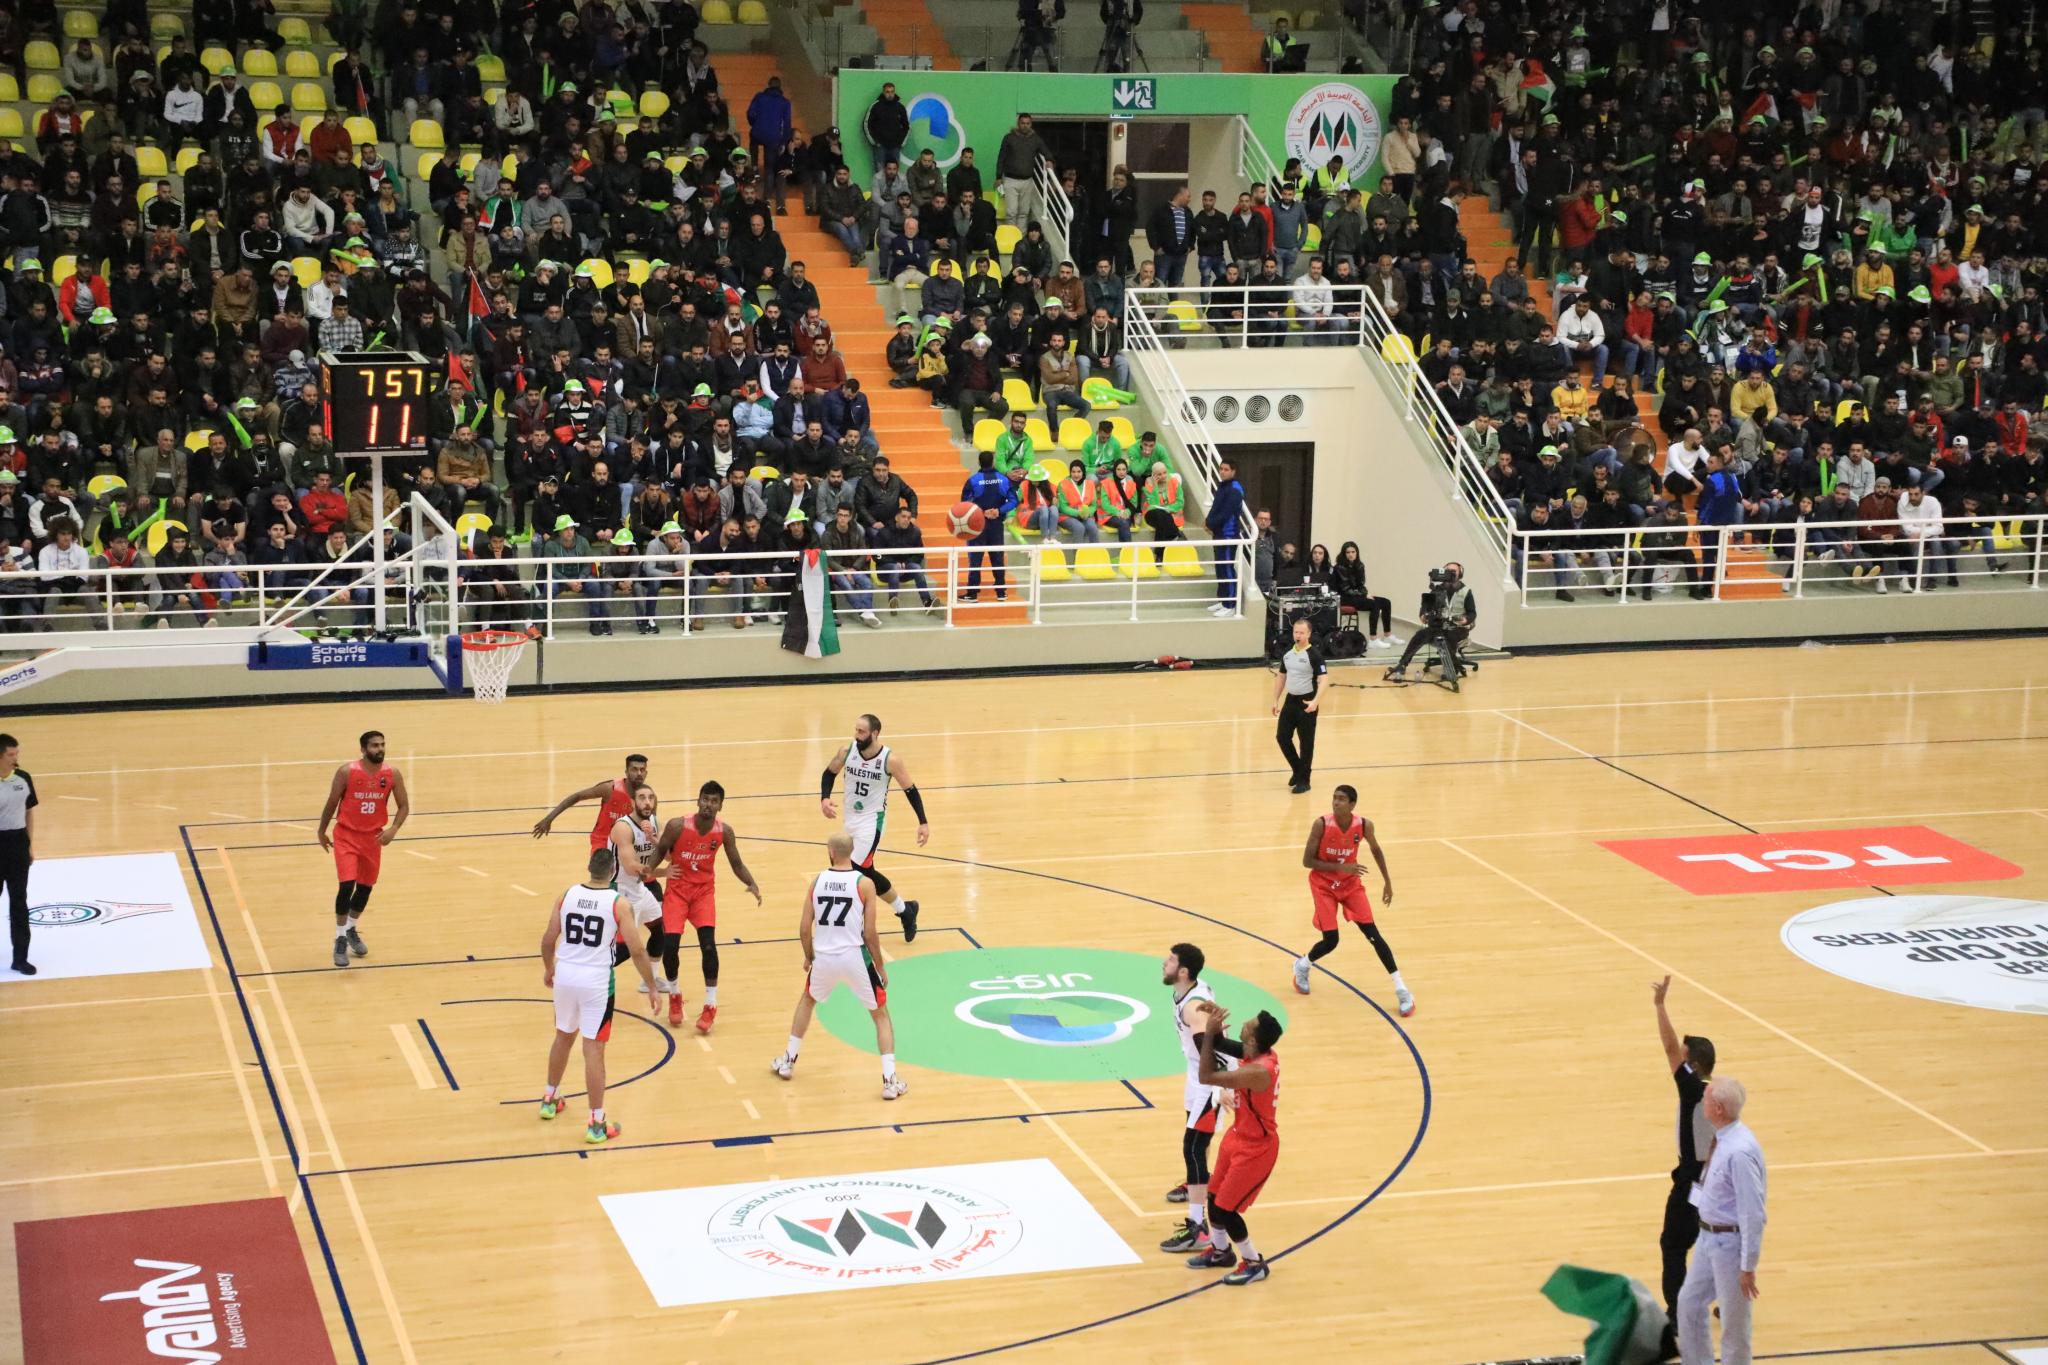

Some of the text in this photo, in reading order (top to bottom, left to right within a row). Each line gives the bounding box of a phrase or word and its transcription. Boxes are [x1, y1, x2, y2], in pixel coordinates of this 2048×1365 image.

[978, 478, 1004, 486] SECURITY
[311, 645, 367, 655] Schelde
[311, 654, 367, 665] Sports
[846, 766, 882, 781] PALESTINE
[854, 781, 870, 797] 15
[360, 801, 376, 814] 28
[634, 843, 653, 854] PALES
[1676, 845, 1952, 873] TCL
[817, 895, 853, 926] 77
[565, 912, 604, 947] 69
[1812, 924, 2037, 947] QUALIFIERS
[1906, 943, 2007, 963] CUP
[969, 973, 1093, 990] جوال
[728, 1180, 982, 1227] ARAB AMERICAN UNIVERSITY
[825, 1193, 861, 1203] 2000
[744, 1249, 832, 1276] الجامعة
[837, 1264, 926, 1278] العربية
[216, 1272, 247, 1349] Advertising Agency
